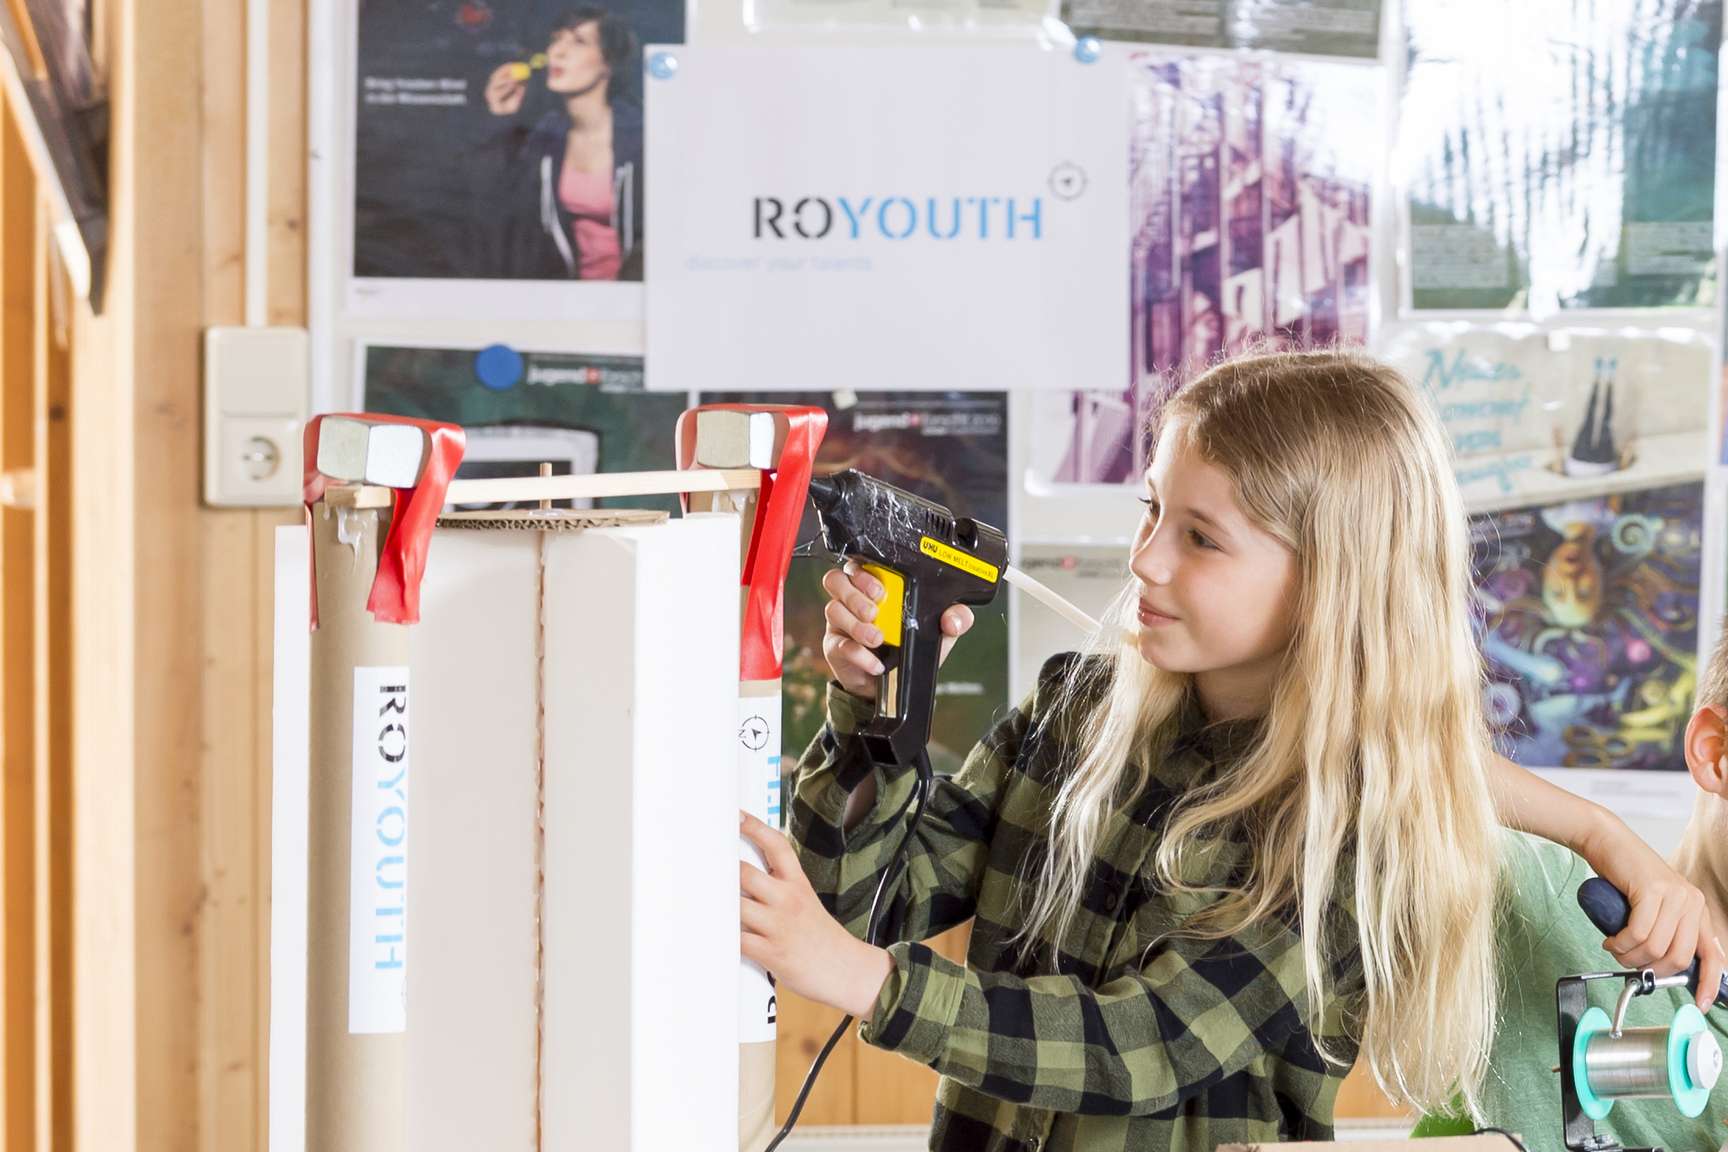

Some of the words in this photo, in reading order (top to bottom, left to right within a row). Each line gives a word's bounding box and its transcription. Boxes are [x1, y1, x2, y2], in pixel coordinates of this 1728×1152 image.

[752, 196, 1040, 241] ROYOUTH
[922, 540, 938, 553] UHU
[374, 684, 407, 969] ROYOUTH
